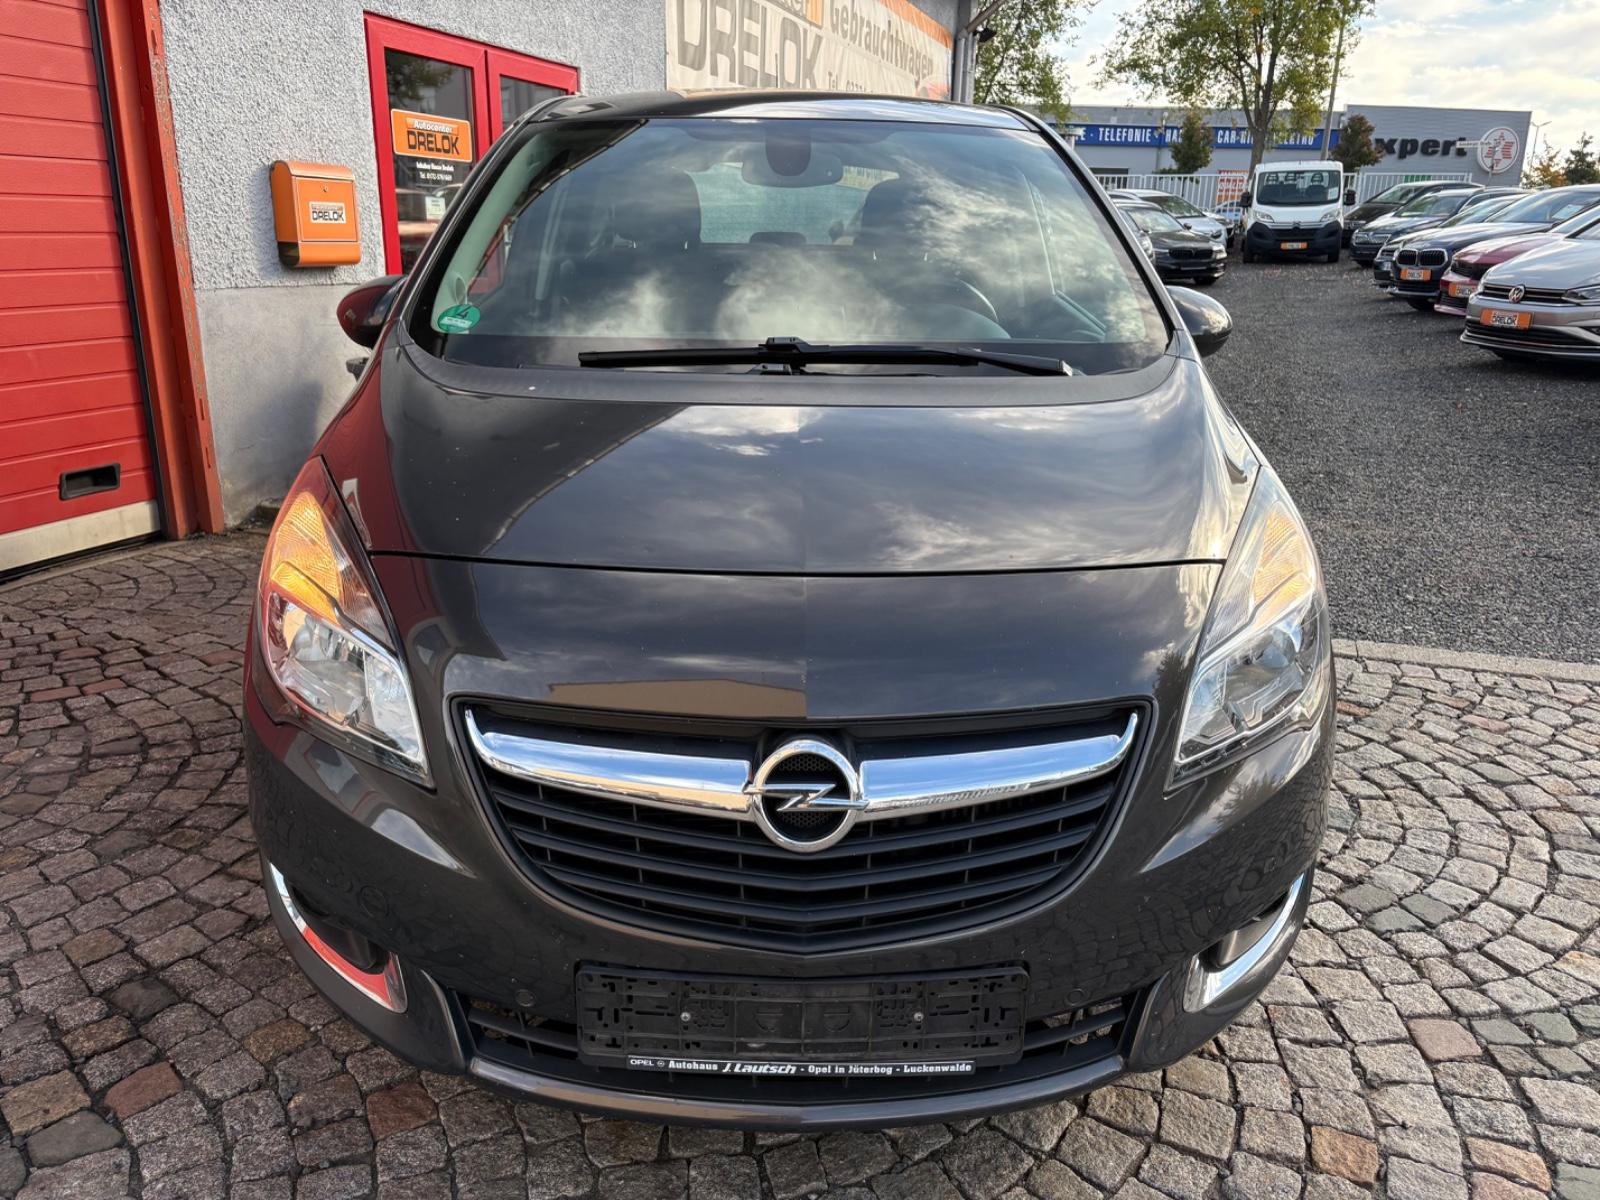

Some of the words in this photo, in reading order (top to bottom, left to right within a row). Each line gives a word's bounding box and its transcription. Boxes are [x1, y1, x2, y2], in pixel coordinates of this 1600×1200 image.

[677, 0, 823, 88] DRELOK
[830, 0, 934, 87] Gebrauchtwagen
[414, 120, 453, 133] Autocenter
[1098, 127, 1152, 142] TELEFONIE
[407, 130, 460, 155] DRELOK
[1374, 137, 1468, 160] xpert
[630, 1059, 654, 1067] OPEL
[668, 1060, 718, 1071] Autohaus
[808, 1064, 831, 1075] Opel
[835, 1064, 846, 1074] in
[848, 1064, 893, 1075] Jüterbog
[903, 1063, 972, 1073] Luckenwalde
